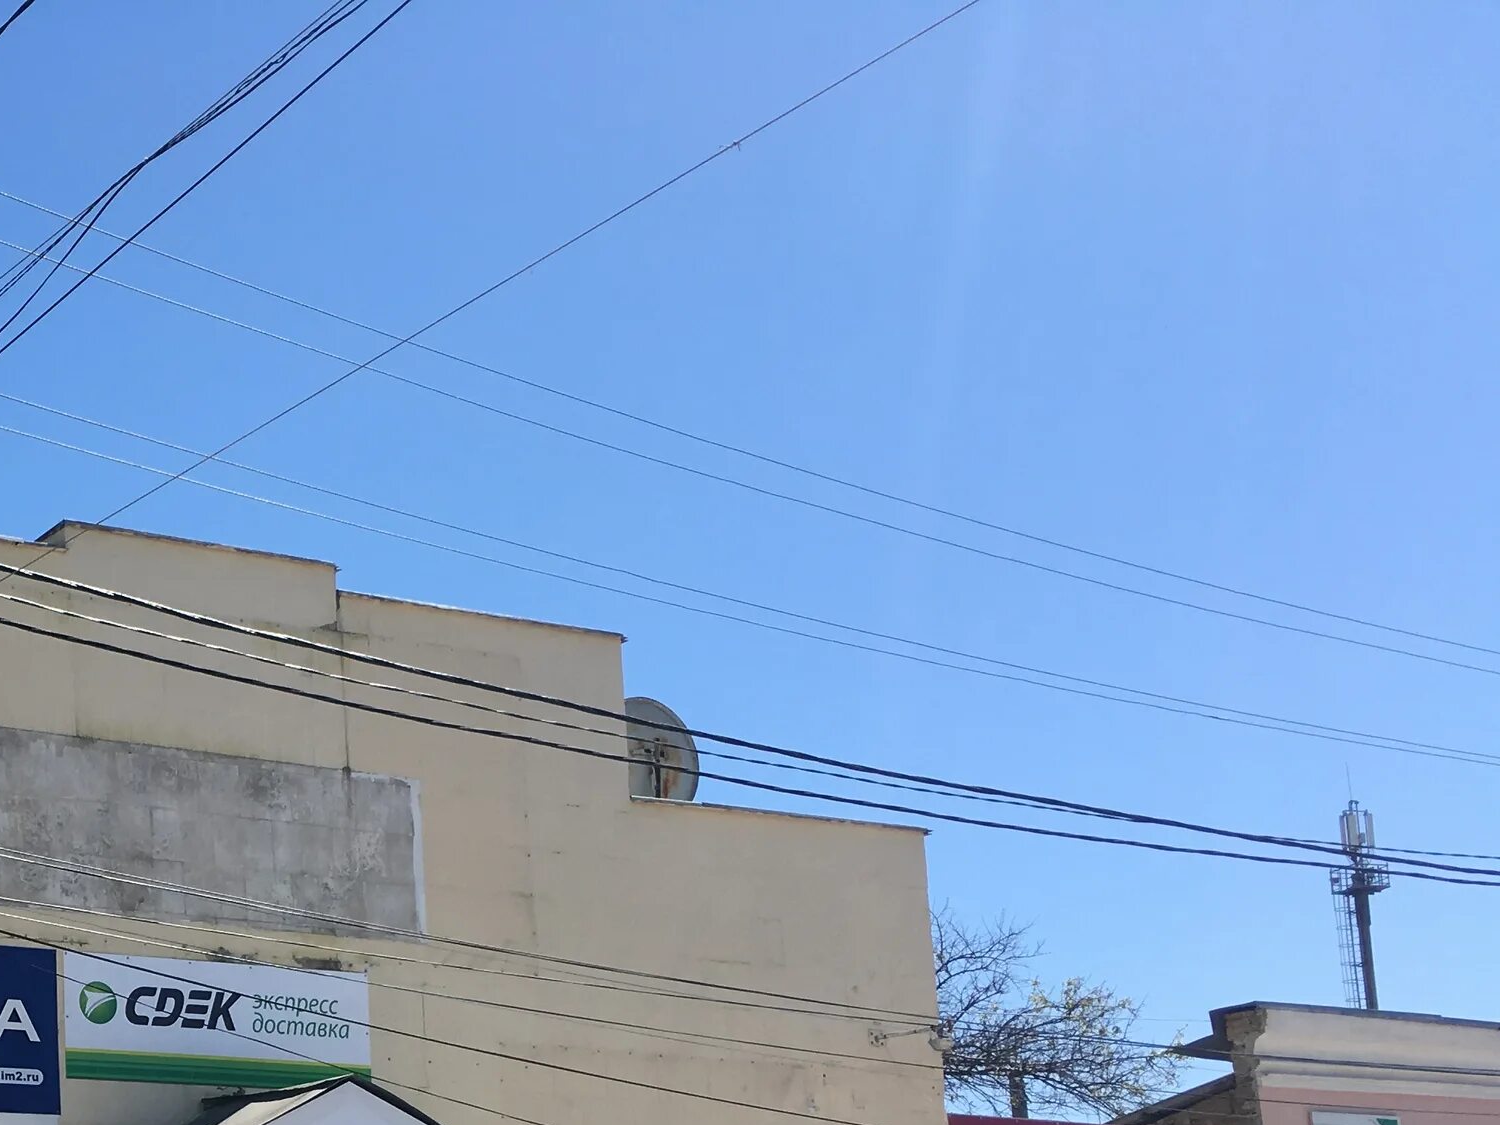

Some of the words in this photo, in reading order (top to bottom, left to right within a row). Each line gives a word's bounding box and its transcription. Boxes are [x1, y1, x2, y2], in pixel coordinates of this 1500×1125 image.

[125, 986, 242, 1031] CDEK
[252, 994, 339, 1015] экспресс
[252, 1013, 350, 1039] доставка
